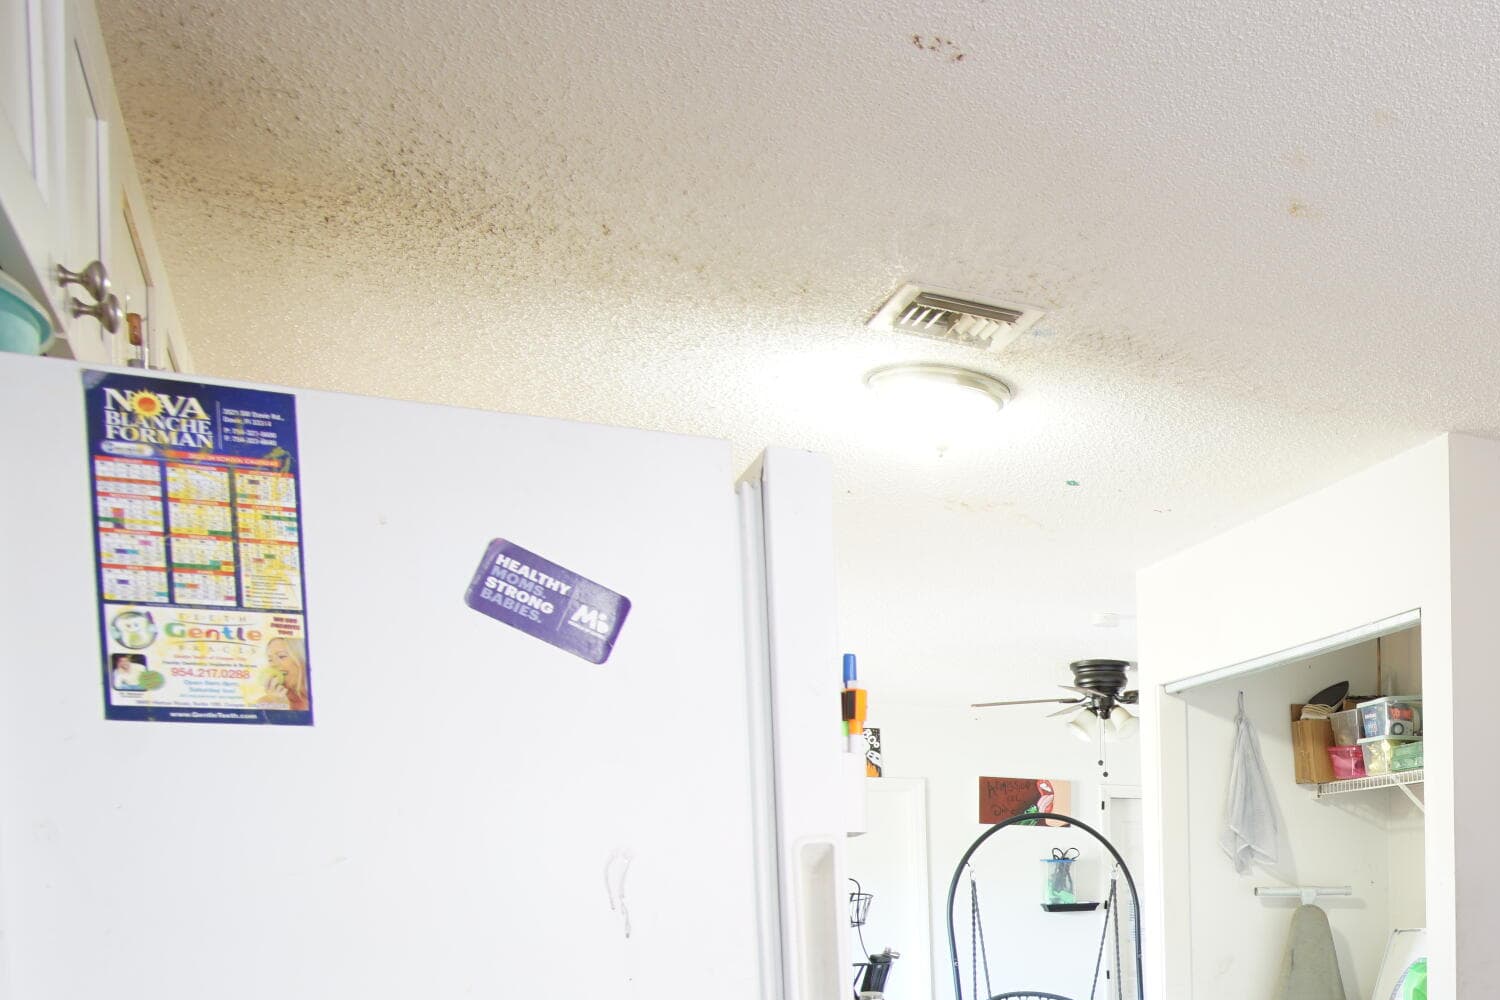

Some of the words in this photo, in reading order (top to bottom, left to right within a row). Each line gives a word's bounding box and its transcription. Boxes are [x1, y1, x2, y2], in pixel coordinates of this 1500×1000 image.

[103, 387, 211, 420] NOVA
[105, 411, 212, 434] BLANCHE
[106, 425, 214, 449] FORMAN
[490, 566, 547, 599] MOMS.
[496, 554, 572, 596] HEALTHY
[480, 588, 542, 624] BABIES.
[485, 576, 554, 614] STRONG
[164, 622, 262, 641] Gentle
